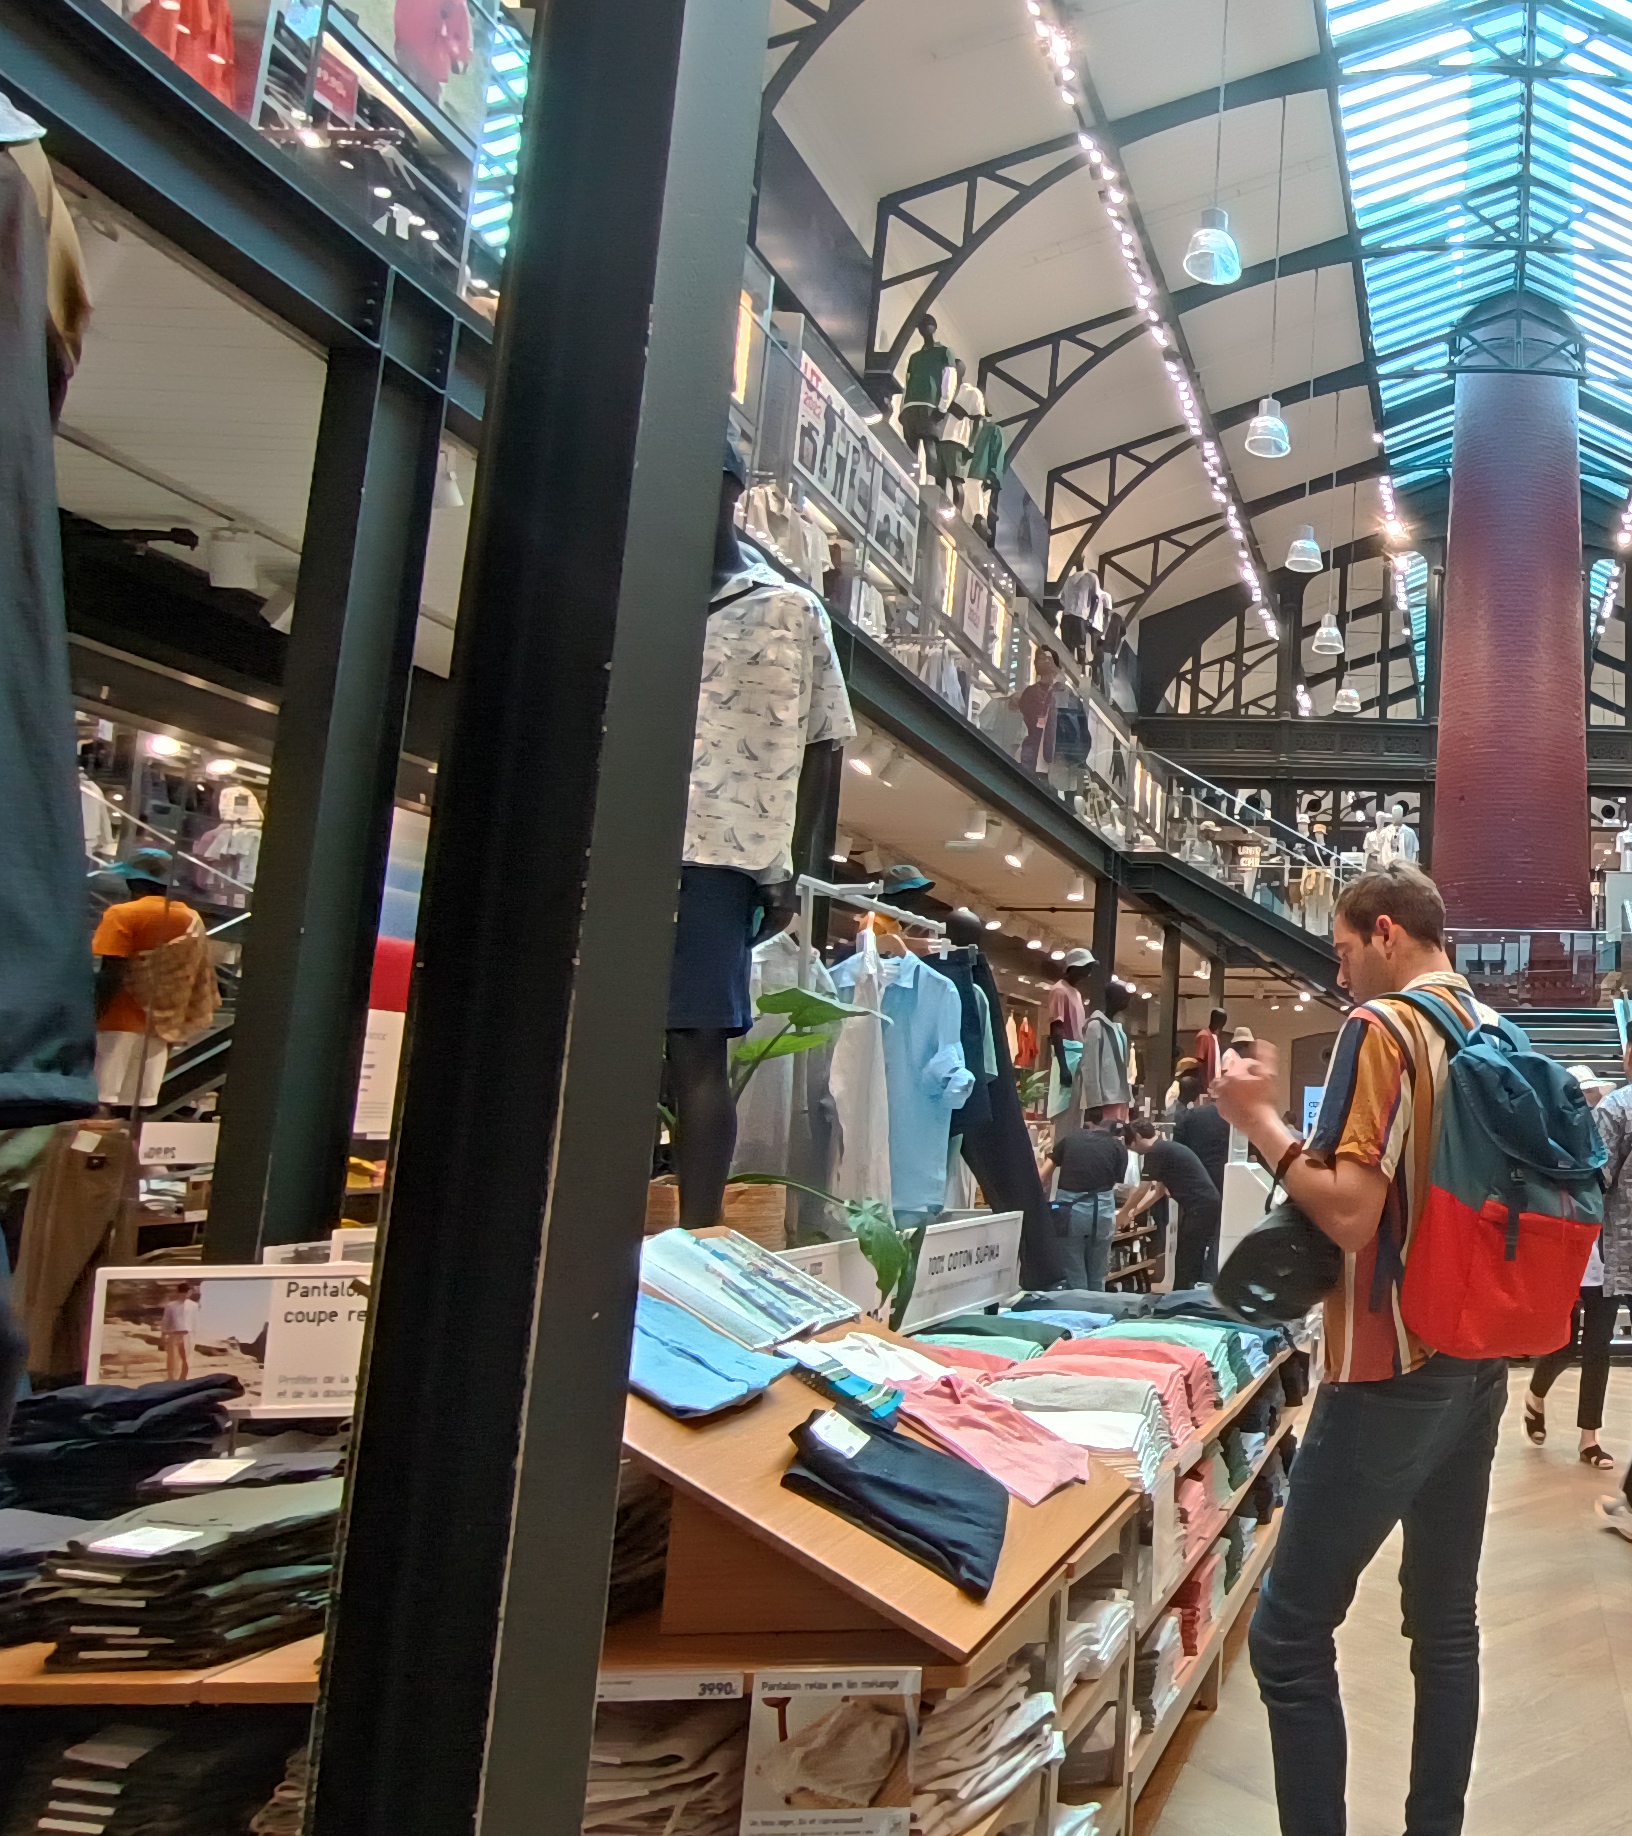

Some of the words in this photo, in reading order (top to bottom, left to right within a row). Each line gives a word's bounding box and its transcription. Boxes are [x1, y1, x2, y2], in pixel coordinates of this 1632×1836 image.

[970, 574, 983, 610] UT
[947, 1248, 974, 1272] COTON
[286, 1281, 361, 1298] Pantalo
[283, 1310, 339, 1327] coupe
[347, 1310, 369, 1322] re
